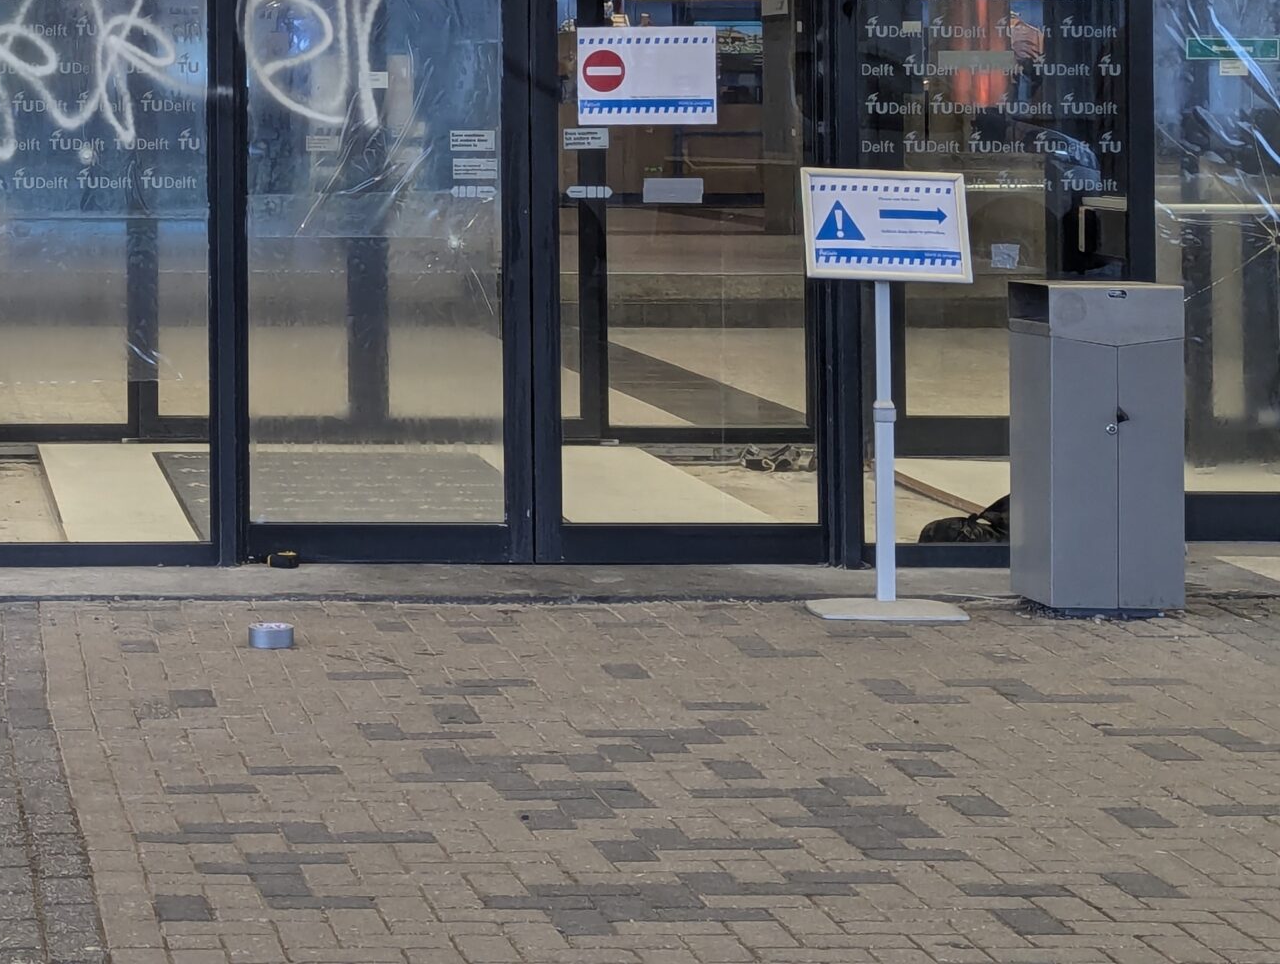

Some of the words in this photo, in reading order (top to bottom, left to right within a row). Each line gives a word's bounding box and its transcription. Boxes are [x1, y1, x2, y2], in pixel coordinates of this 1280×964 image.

[930, 25, 986, 38] TUDelft
[1060, 25, 1117, 38] TUDelft
[1033, 63, 1090, 76] TUDelft
[141, 99, 196, 112] TUDelft
[865, 102, 922, 115] TUDelft
[996, 102, 1052, 115] TUDelft
[1061, 102, 1118, 115] TUDelft
[903, 140, 960, 153] TUDelft
[969, 140, 1024, 153] TUDelft
[13, 176, 68, 189] TUDelft
[77, 176, 132, 189] TUDelft
[141, 176, 196, 189] TUDelft
[1061, 178, 1118, 192] TUDelft
